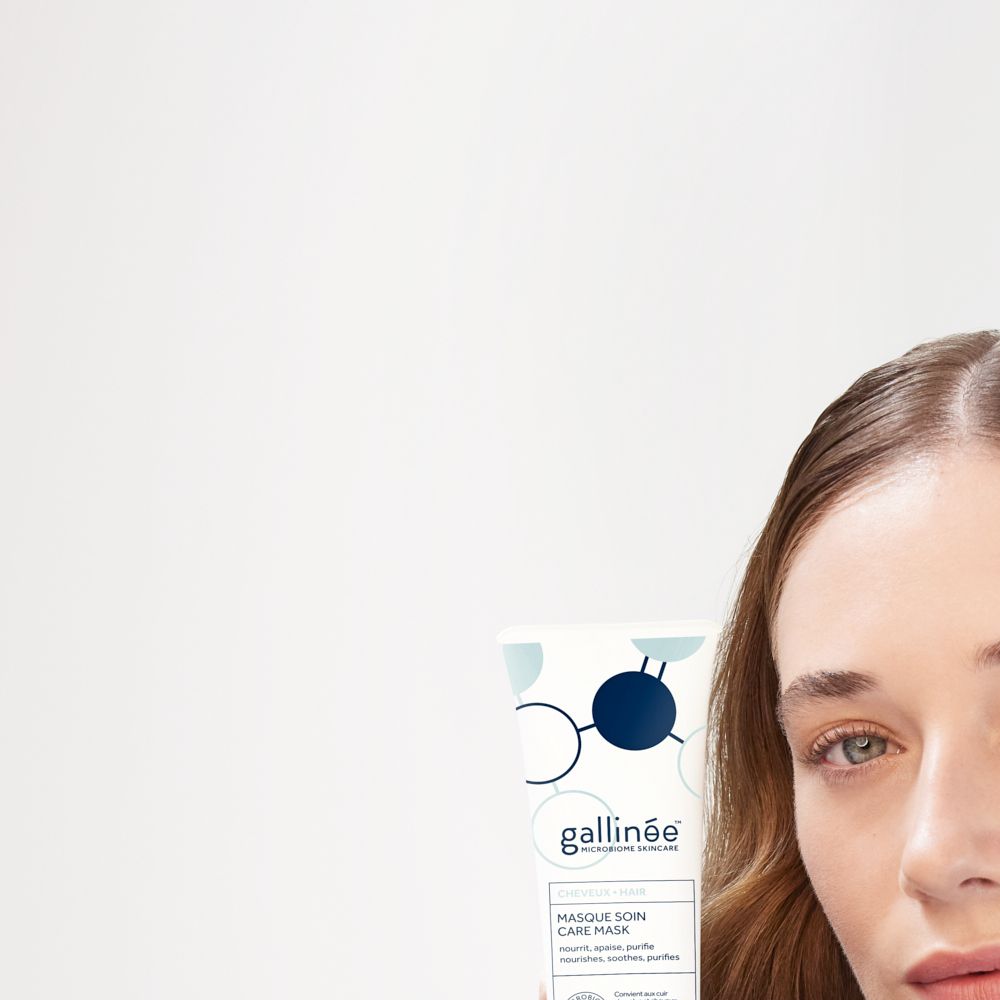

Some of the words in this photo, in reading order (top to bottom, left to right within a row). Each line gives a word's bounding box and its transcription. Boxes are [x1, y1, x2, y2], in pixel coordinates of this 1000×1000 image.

[581, 845, 635, 853] MICROBIOME
[558, 888, 610, 898] CHEVEUX
[620, 887, 646, 896] HAIR
[557, 912, 612, 923] MASQUE
[615, 911, 646, 922] SOIN
[557, 926, 591, 937] CARE
[594, 925, 630, 935] MASK
[559, 944, 592, 952] nourrit,
[593, 943, 625, 953] apaise,
[626, 942, 655, 952] purifie
[559, 955, 605, 963] nourishes,
[607, 954, 645, 962] soothes,
[647, 953, 680, 962] purifies
